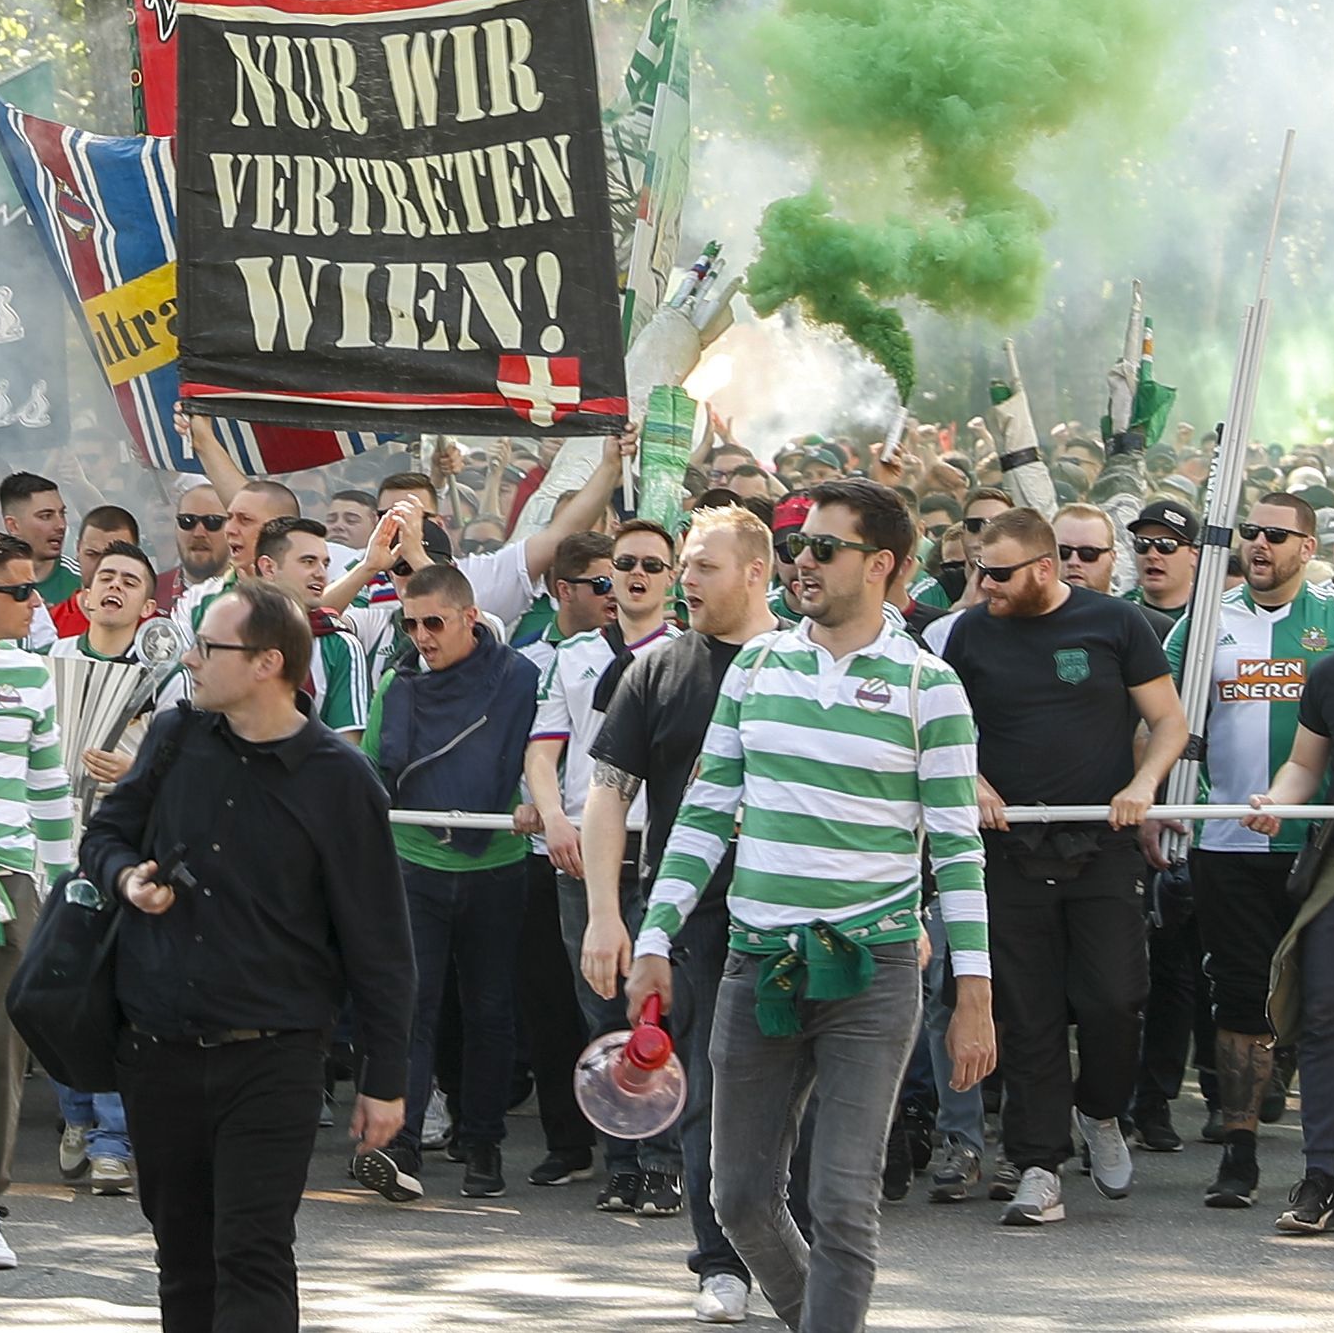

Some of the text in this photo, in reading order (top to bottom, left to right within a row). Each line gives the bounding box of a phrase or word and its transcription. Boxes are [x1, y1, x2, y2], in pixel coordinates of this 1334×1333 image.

[222, 28, 370, 136] NUR
[380, 17, 545, 131] WIR
[208, 133, 577, 238] VERTRETEN
[233, 249, 567, 354] WIEN!
[1240, 661, 1303, 677] WIEN
